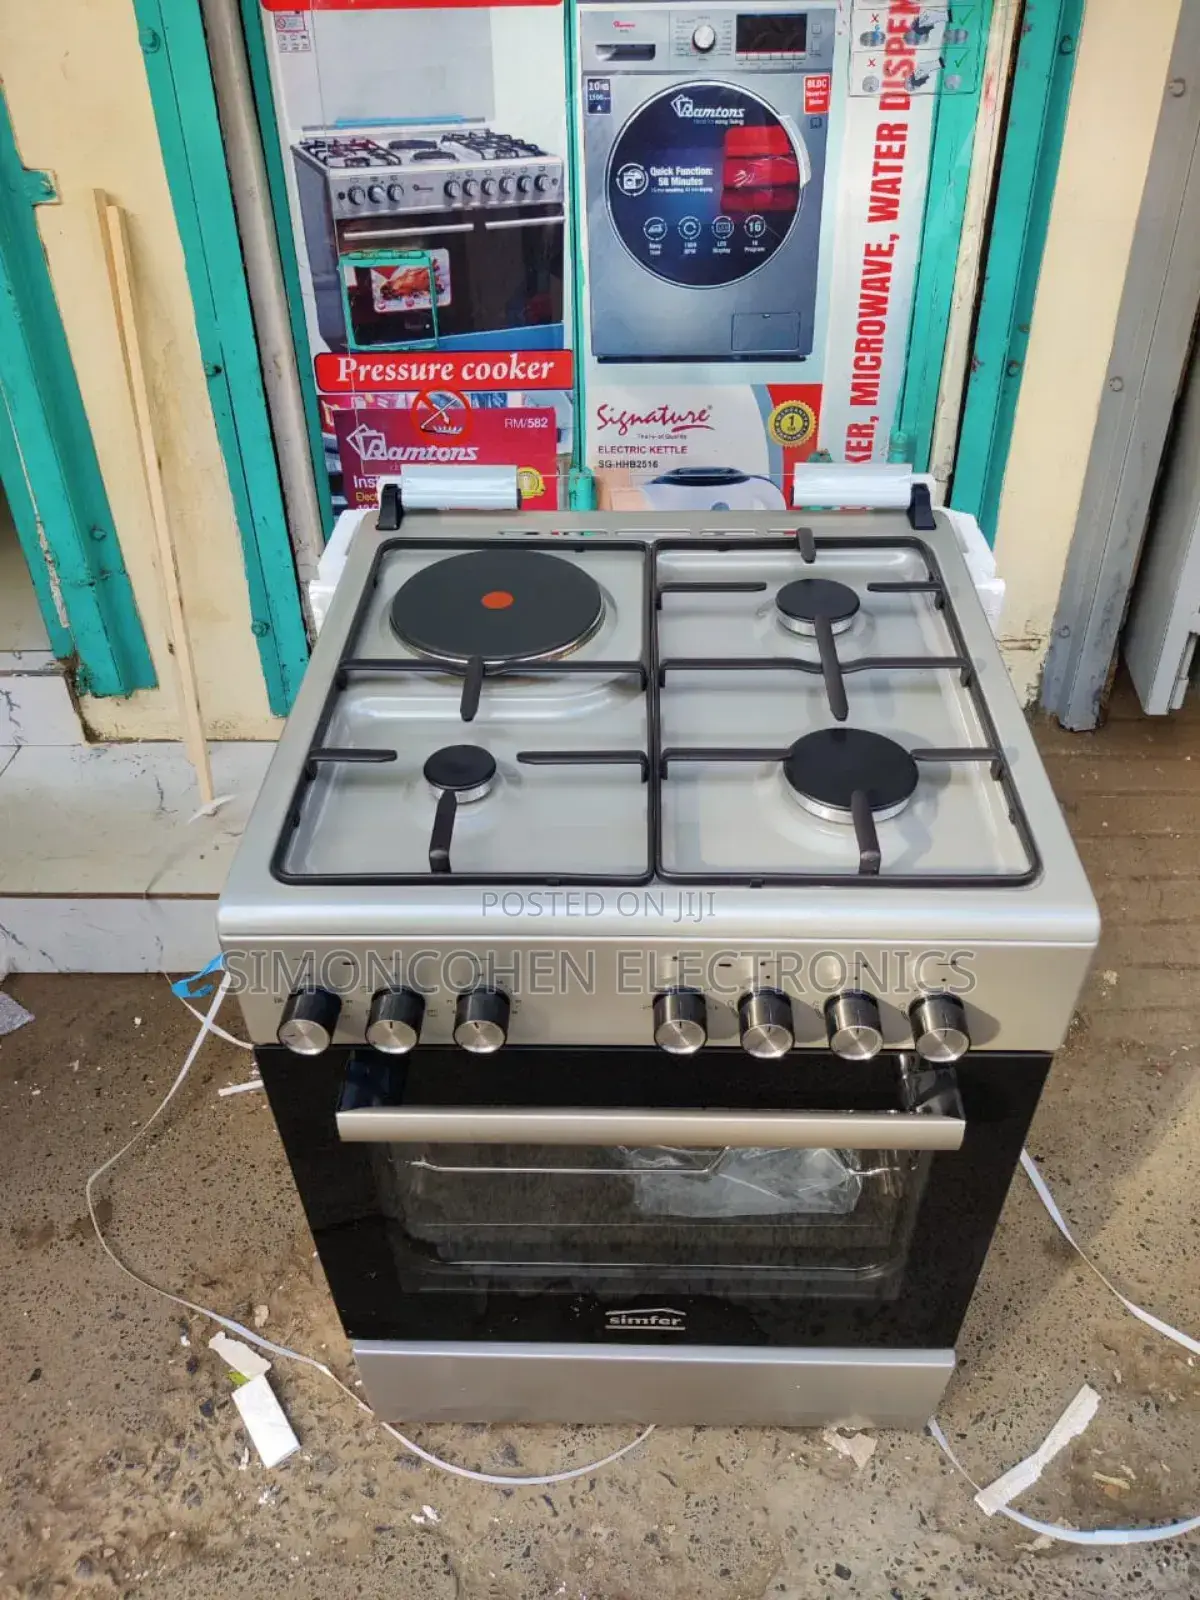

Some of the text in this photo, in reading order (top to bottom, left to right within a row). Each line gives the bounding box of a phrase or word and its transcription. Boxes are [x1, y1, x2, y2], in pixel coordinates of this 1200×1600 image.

[676, 98, 745, 118] Ramtons
[650, 166, 714, 177] Quick Function:
[867, 123, 908, 223] WATER
[671, 176, 704, 186] Minutes
[850, 233, 900, 406] MICROWAVE,
[336, 353, 555, 383] Pressure cooker
[504, 417, 549, 429] RM/582
[358, 432, 480, 462] Ramtons
[598, 445, 688, 455] ELECTRIC KETTLE
[609, 1315, 682, 1326] simfer
